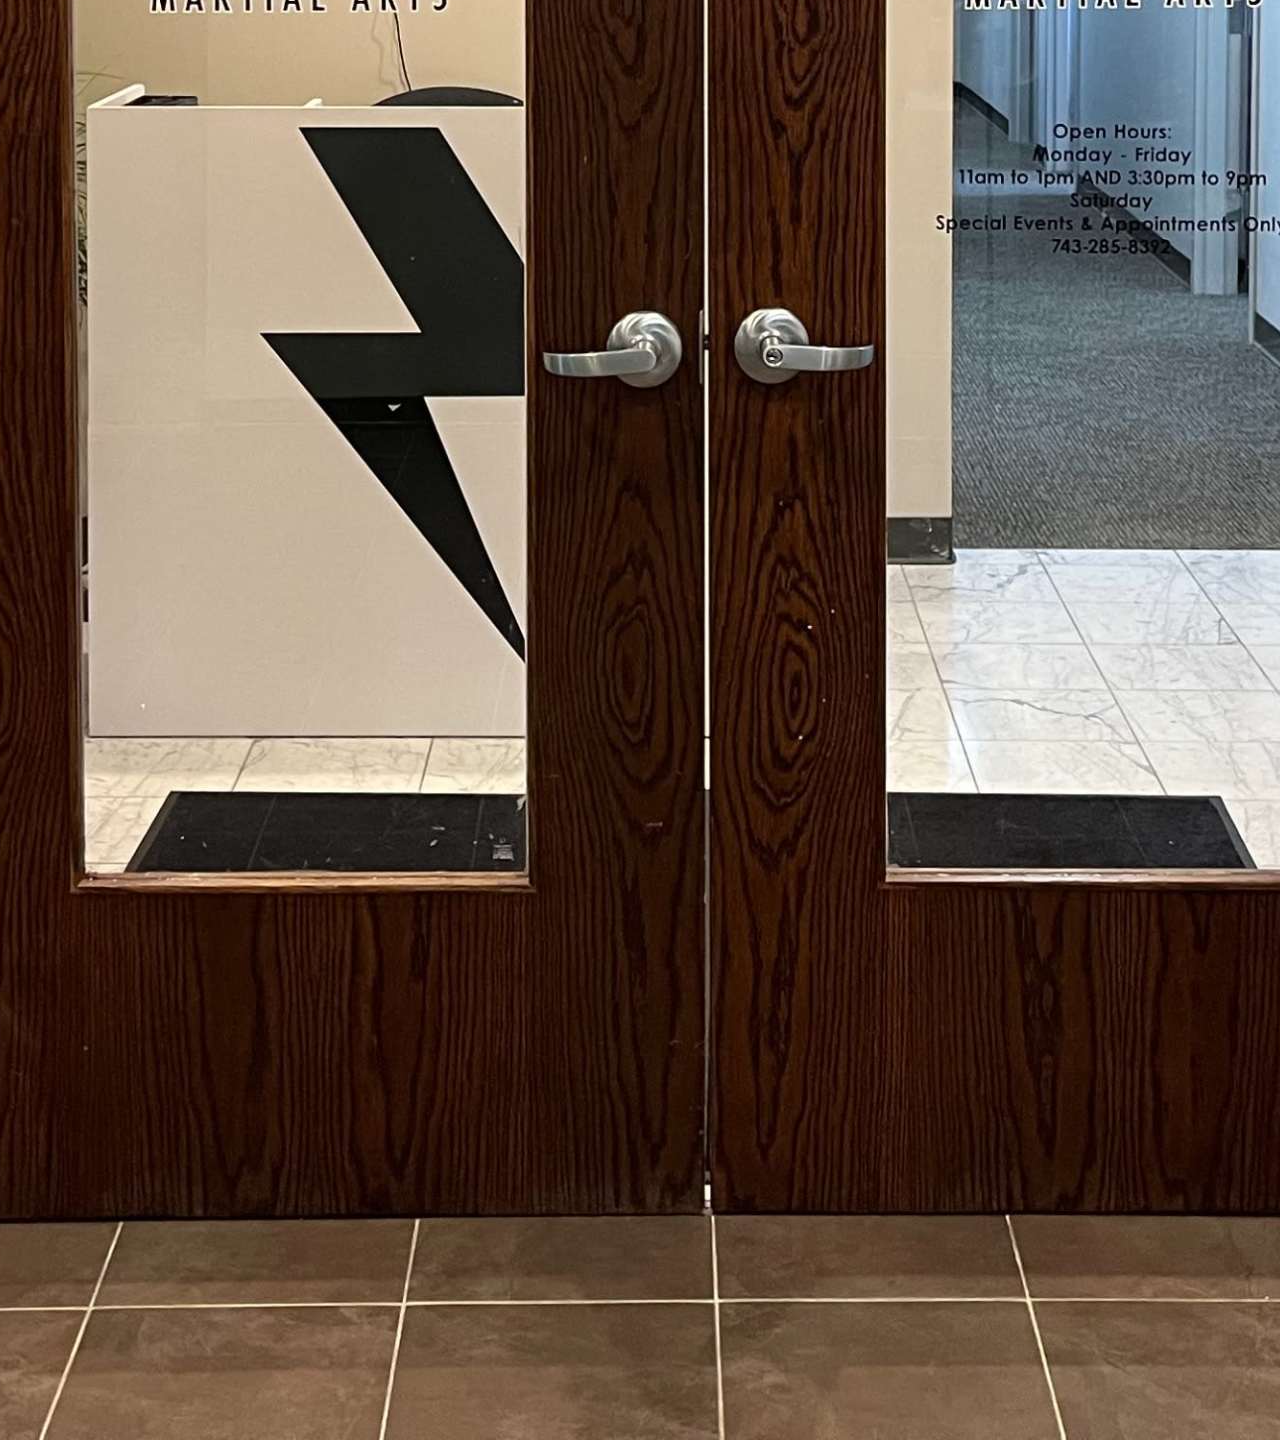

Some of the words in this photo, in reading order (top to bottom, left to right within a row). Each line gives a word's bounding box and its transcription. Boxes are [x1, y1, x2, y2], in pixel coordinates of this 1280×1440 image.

[1053, 124, 1106, 141] Open
[1114, 124, 1172, 140] Hours:
[1033, 145, 1112, 165] Monday
[1135, 147, 1192, 166] Friday
[959, 169, 1005, 185] 11am
[1011, 169, 1029, 185] to
[1035, 169, 1074, 188] 1pm
[1080, 170, 1122, 186] AND
[1127, 170, 1195, 188] 3:30pm
[1202, 170, 1219, 186] to
[1226, 170, 1267, 188] 9pm
[1070, 192, 1153, 211] Saturday
[936, 215, 1007, 233] Special
[1014, 216, 1073, 231] Events
[1080, 216, 1093, 231] &
[1100, 216, 1236, 235] Appointments
[1052, 239, 1170, 255] 743-285-8392
